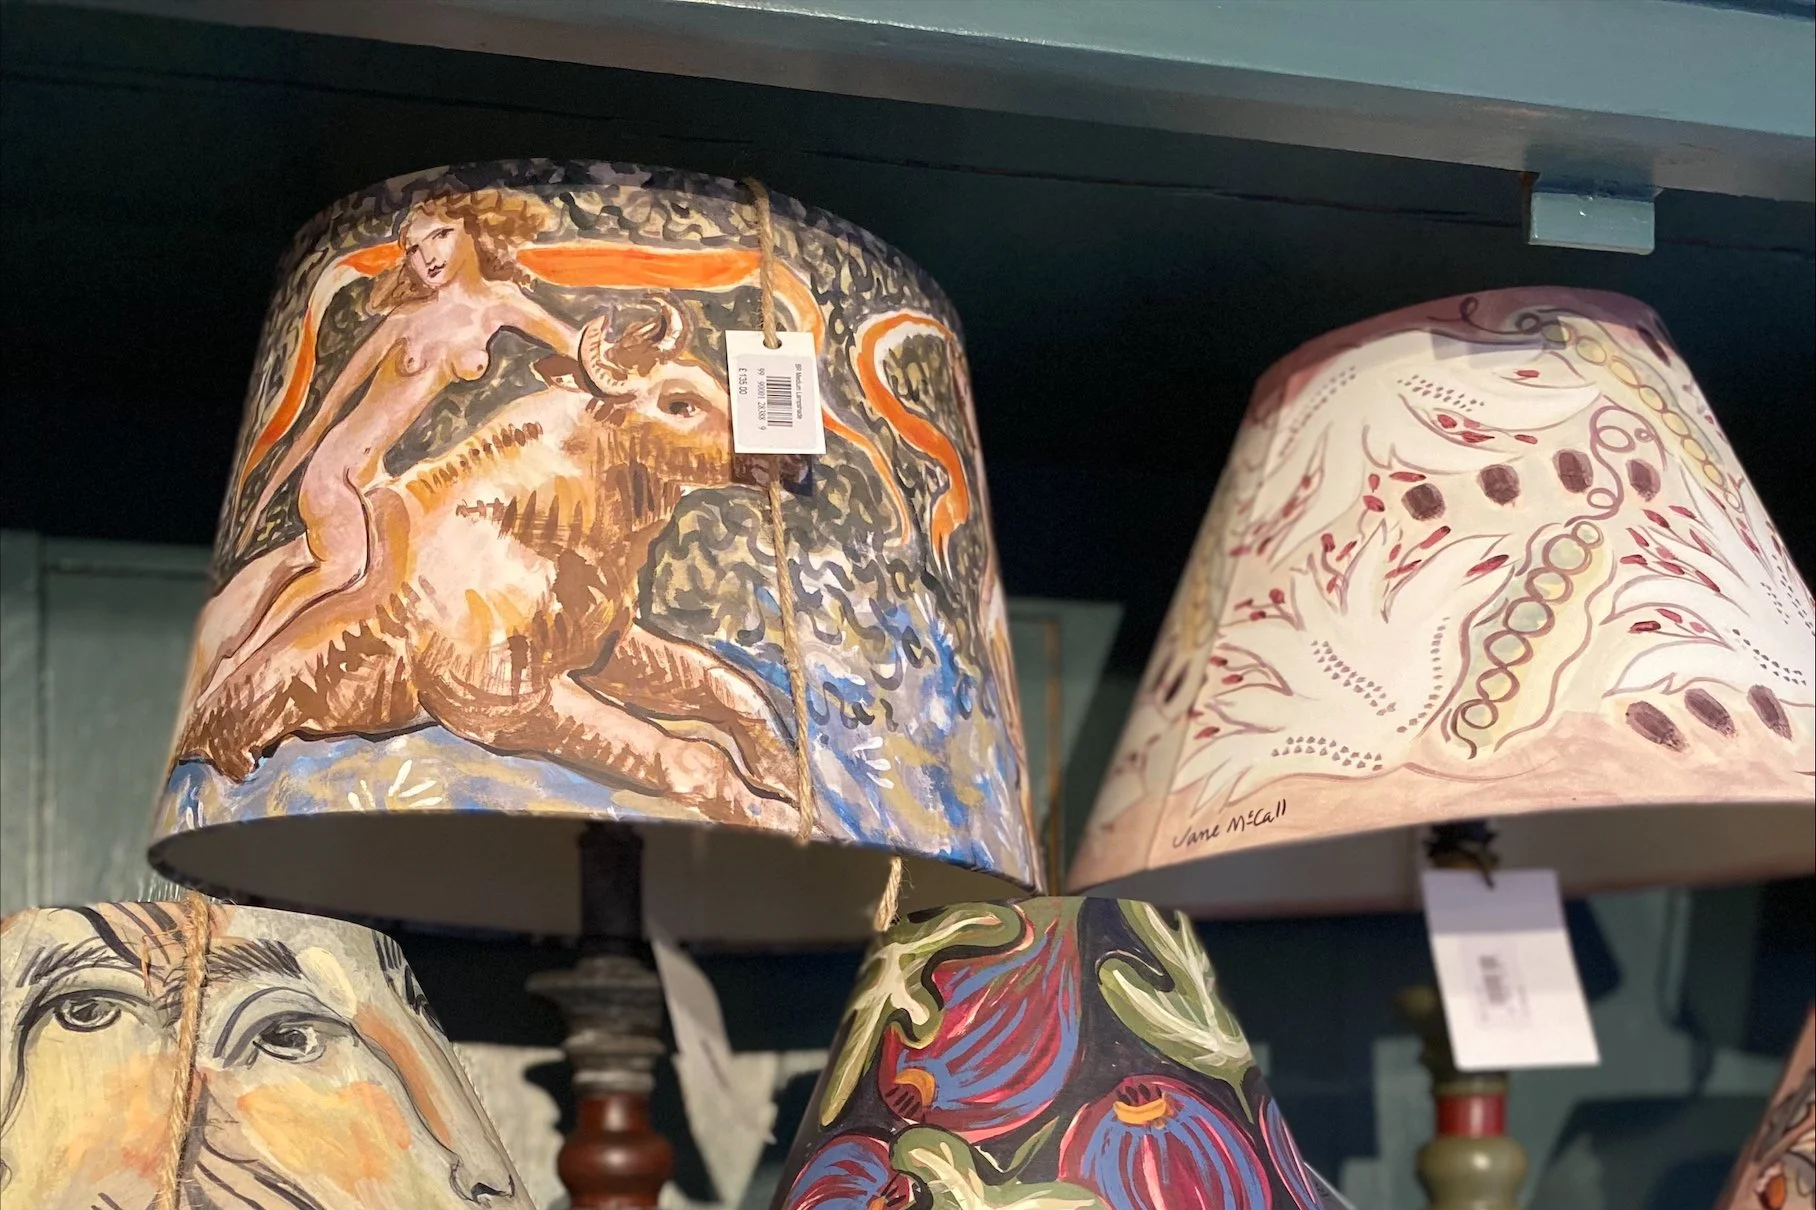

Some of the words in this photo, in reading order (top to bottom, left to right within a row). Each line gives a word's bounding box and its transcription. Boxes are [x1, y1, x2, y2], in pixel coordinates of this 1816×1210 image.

[757, 368, 765, 376] 99
[757, 381, 766, 398] 90001
[757, 401, 766, 420] 28388
[795, 392, 803, 419] Lampshade
[1173, 825, 1220, 848] Jane
